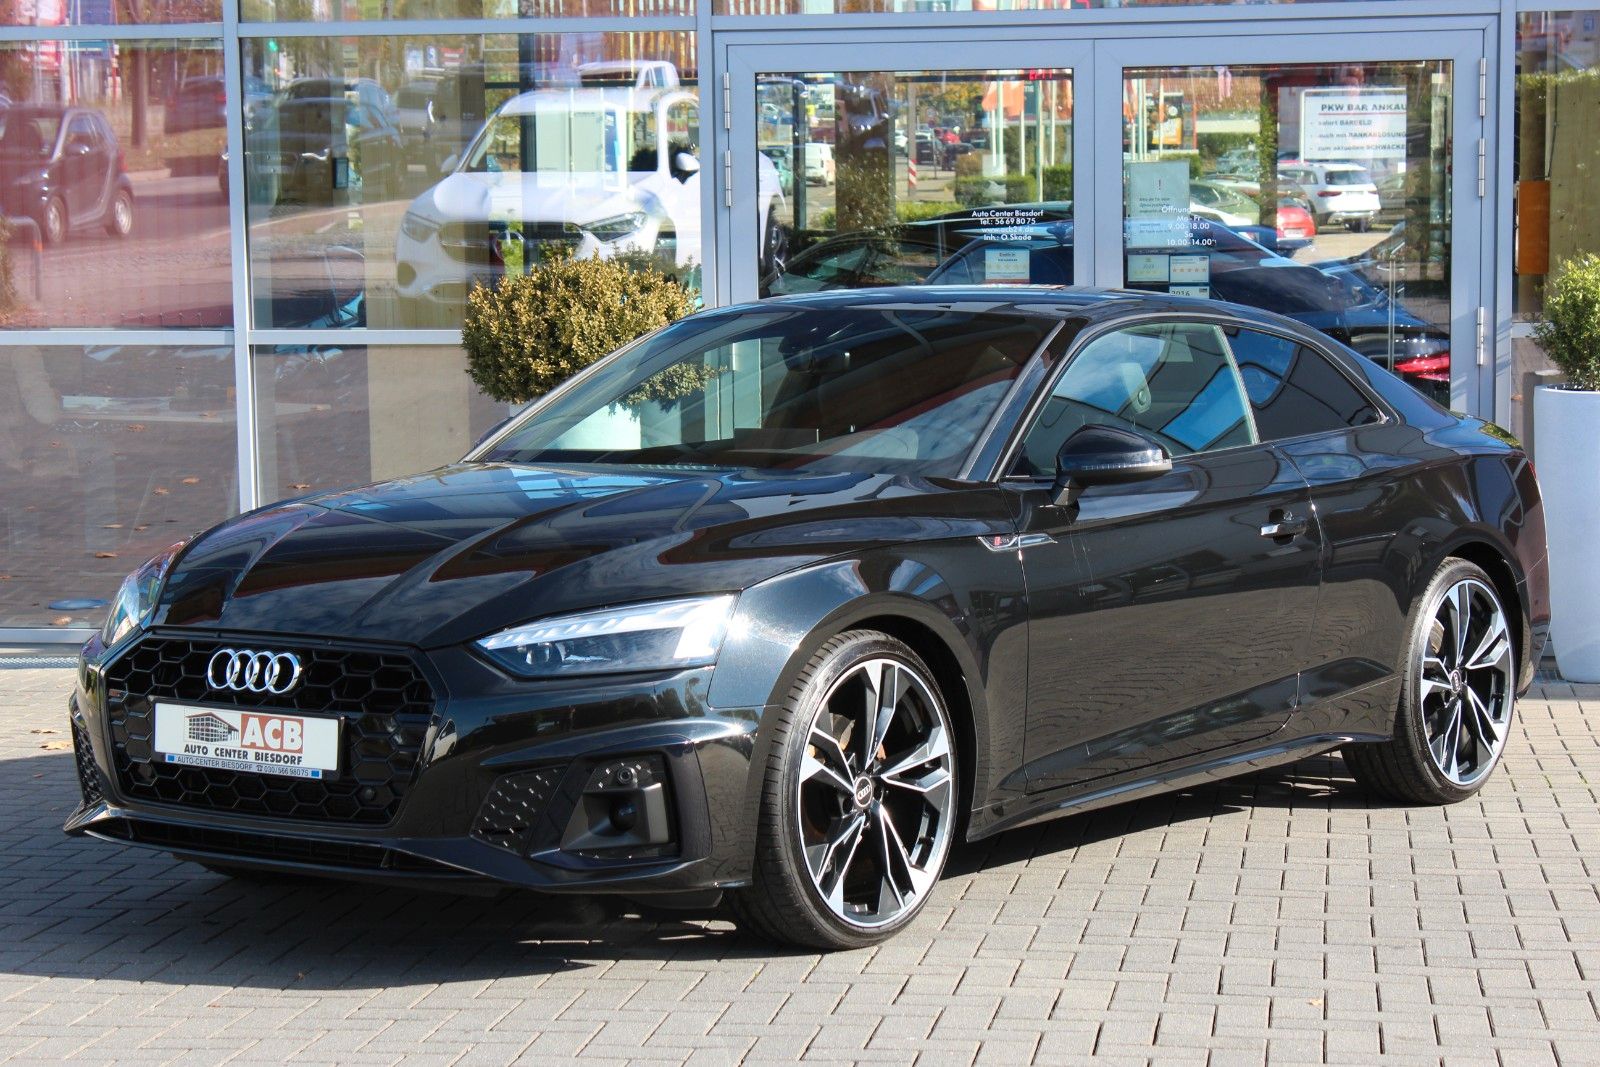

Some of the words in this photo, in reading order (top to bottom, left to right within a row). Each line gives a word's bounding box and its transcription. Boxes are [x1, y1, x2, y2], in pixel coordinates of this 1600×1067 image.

[1321, 104, 1344, 112] PKW
[972, 210, 989, 218] Auto
[1015, 209, 1044, 217] Biesdorf
[1010, 233, 1032, 241] Skade
[242, 716, 303, 751] ACB
[184, 743, 209, 756] AUTO
[214, 747, 249, 760] CENTER
[254, 751, 303, 766] BIESDORF
[177, 755, 220, 768] AUTO-CENTER
[221, 760, 253, 771] BIESDORF
